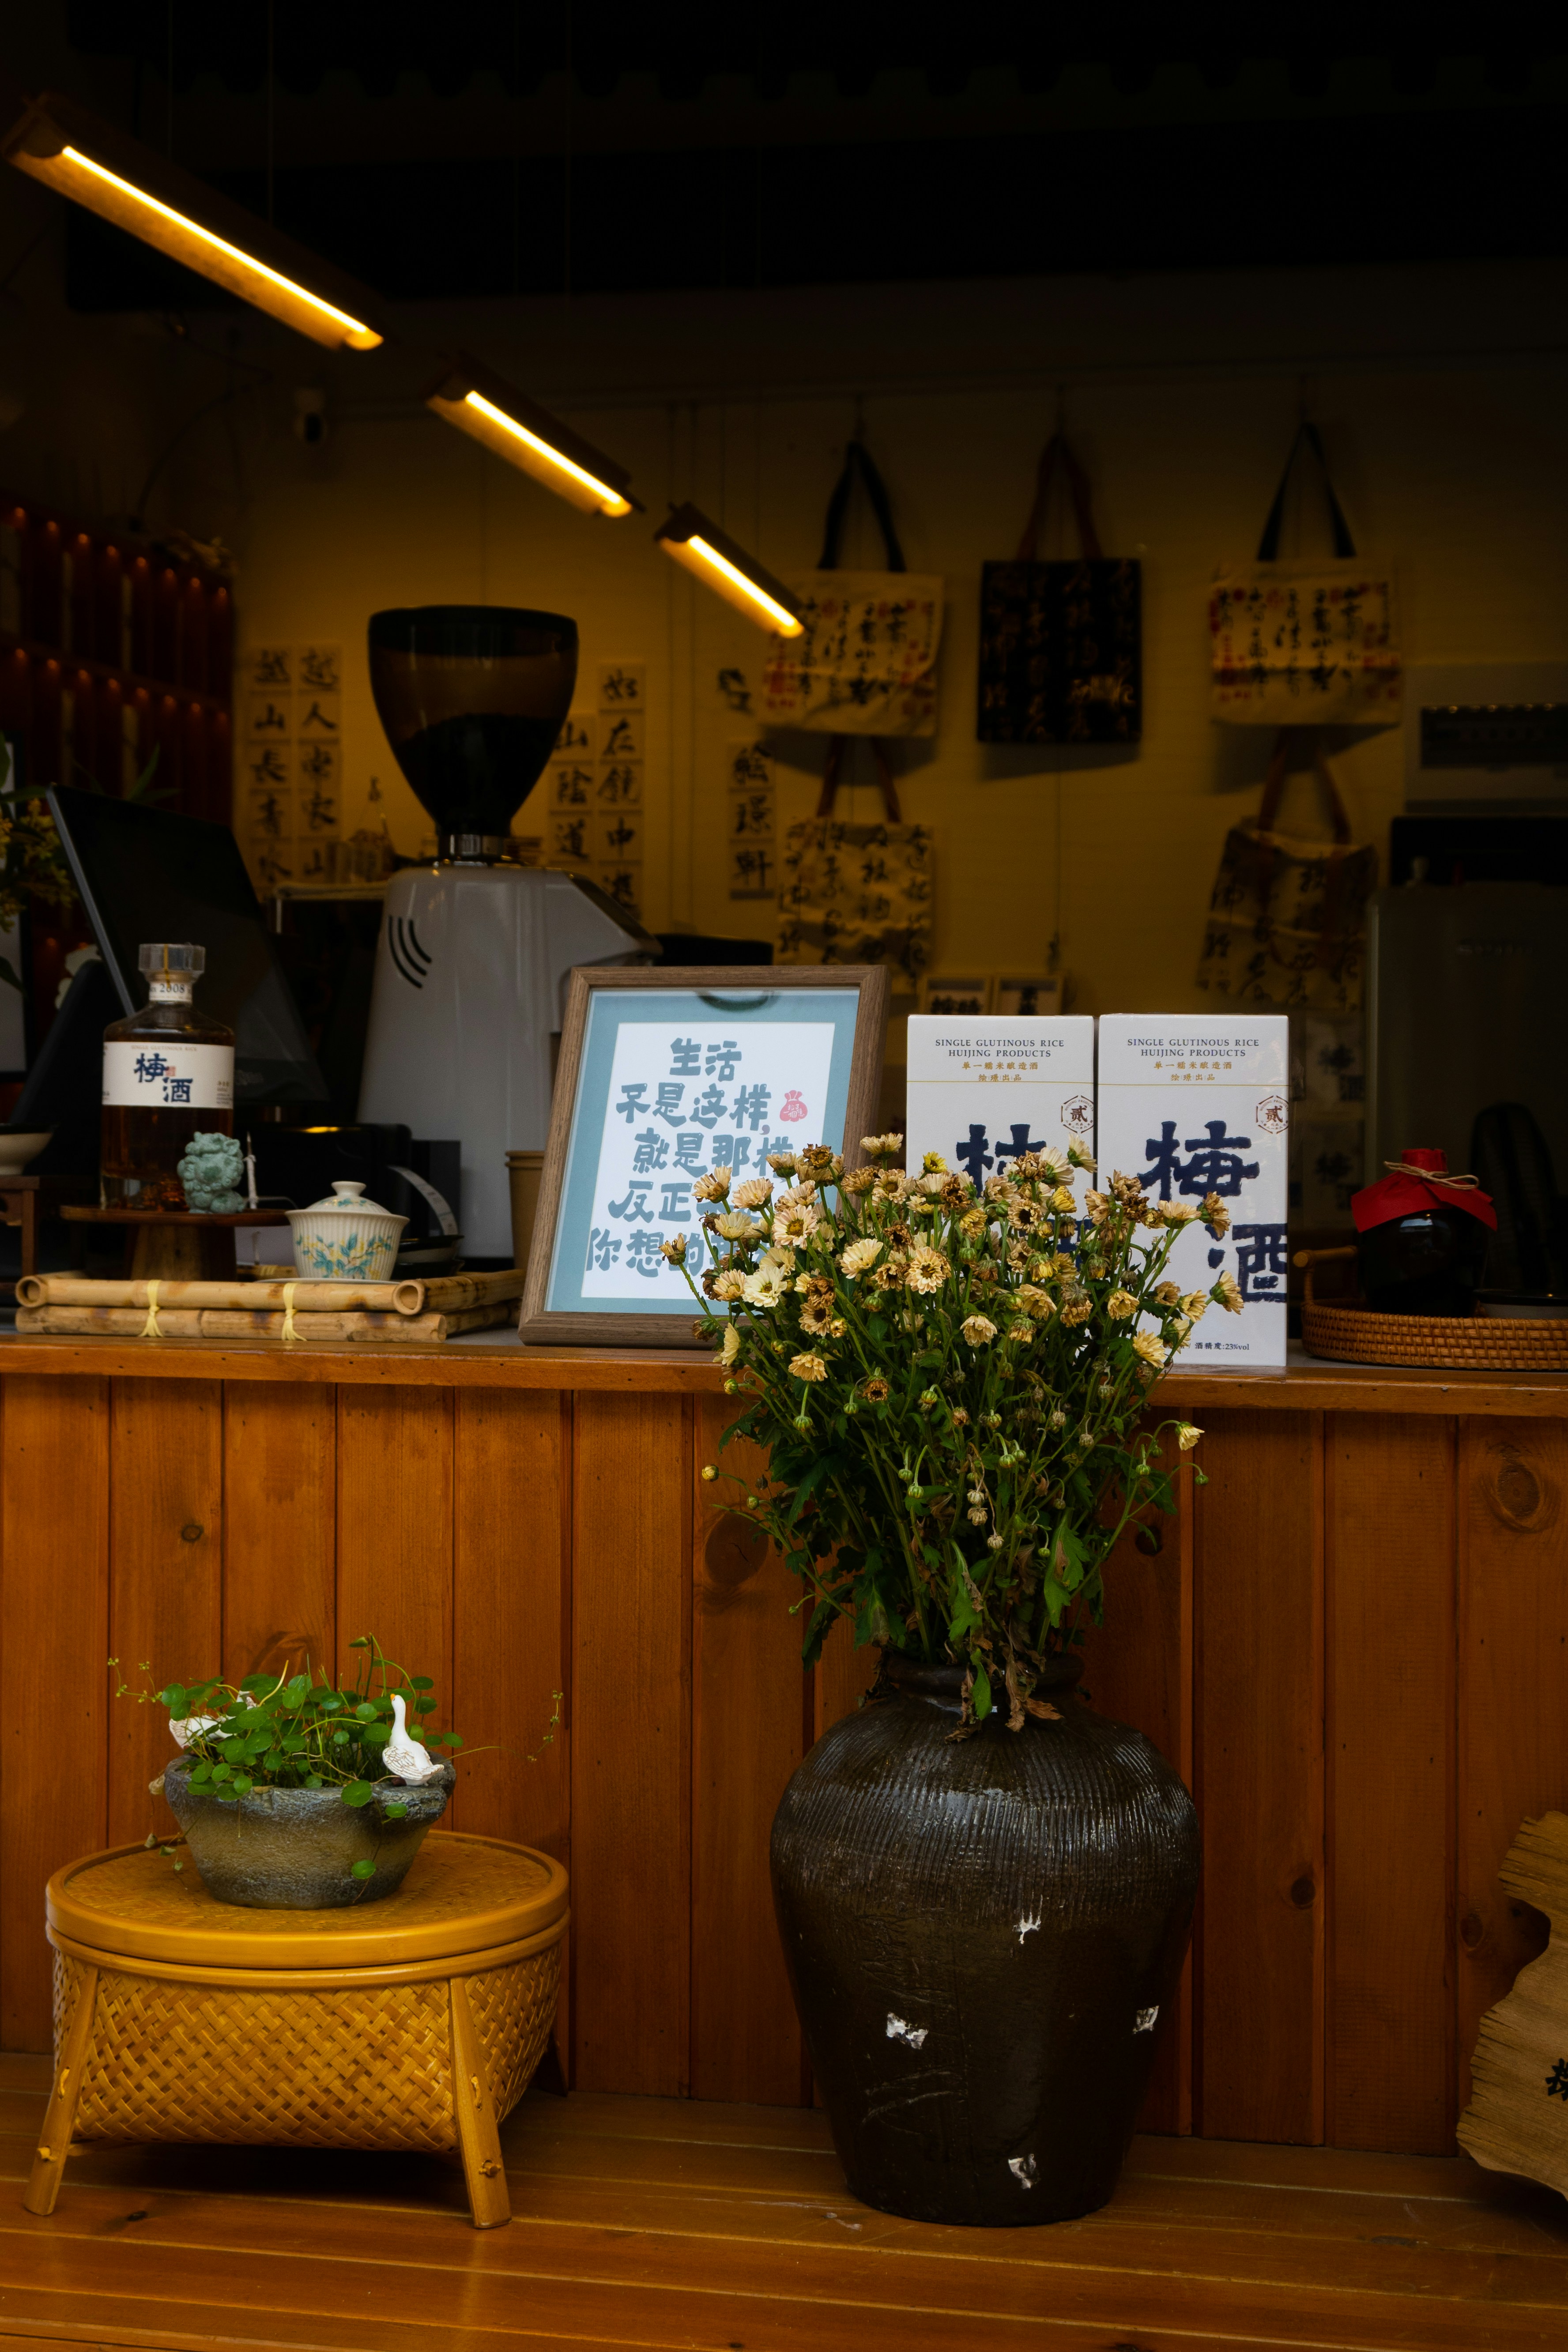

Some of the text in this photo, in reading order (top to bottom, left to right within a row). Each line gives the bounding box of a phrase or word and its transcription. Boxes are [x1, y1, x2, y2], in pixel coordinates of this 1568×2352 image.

[159, 983, 185, 993] 2008
[949, 1050, 991, 1058] HUIJING
[1141, 1049, 1184, 1058] HUIJING
[669, 1037, 742, 1082] 生活
[961, 1062, 1038, 1070] 单一糯米酿造酒
[1154, 1061, 1232, 1070] 单一糯米酿造酒
[1070, 1105, 1088, 1123] 贰
[1265, 1105, 1283, 1123] 贰
